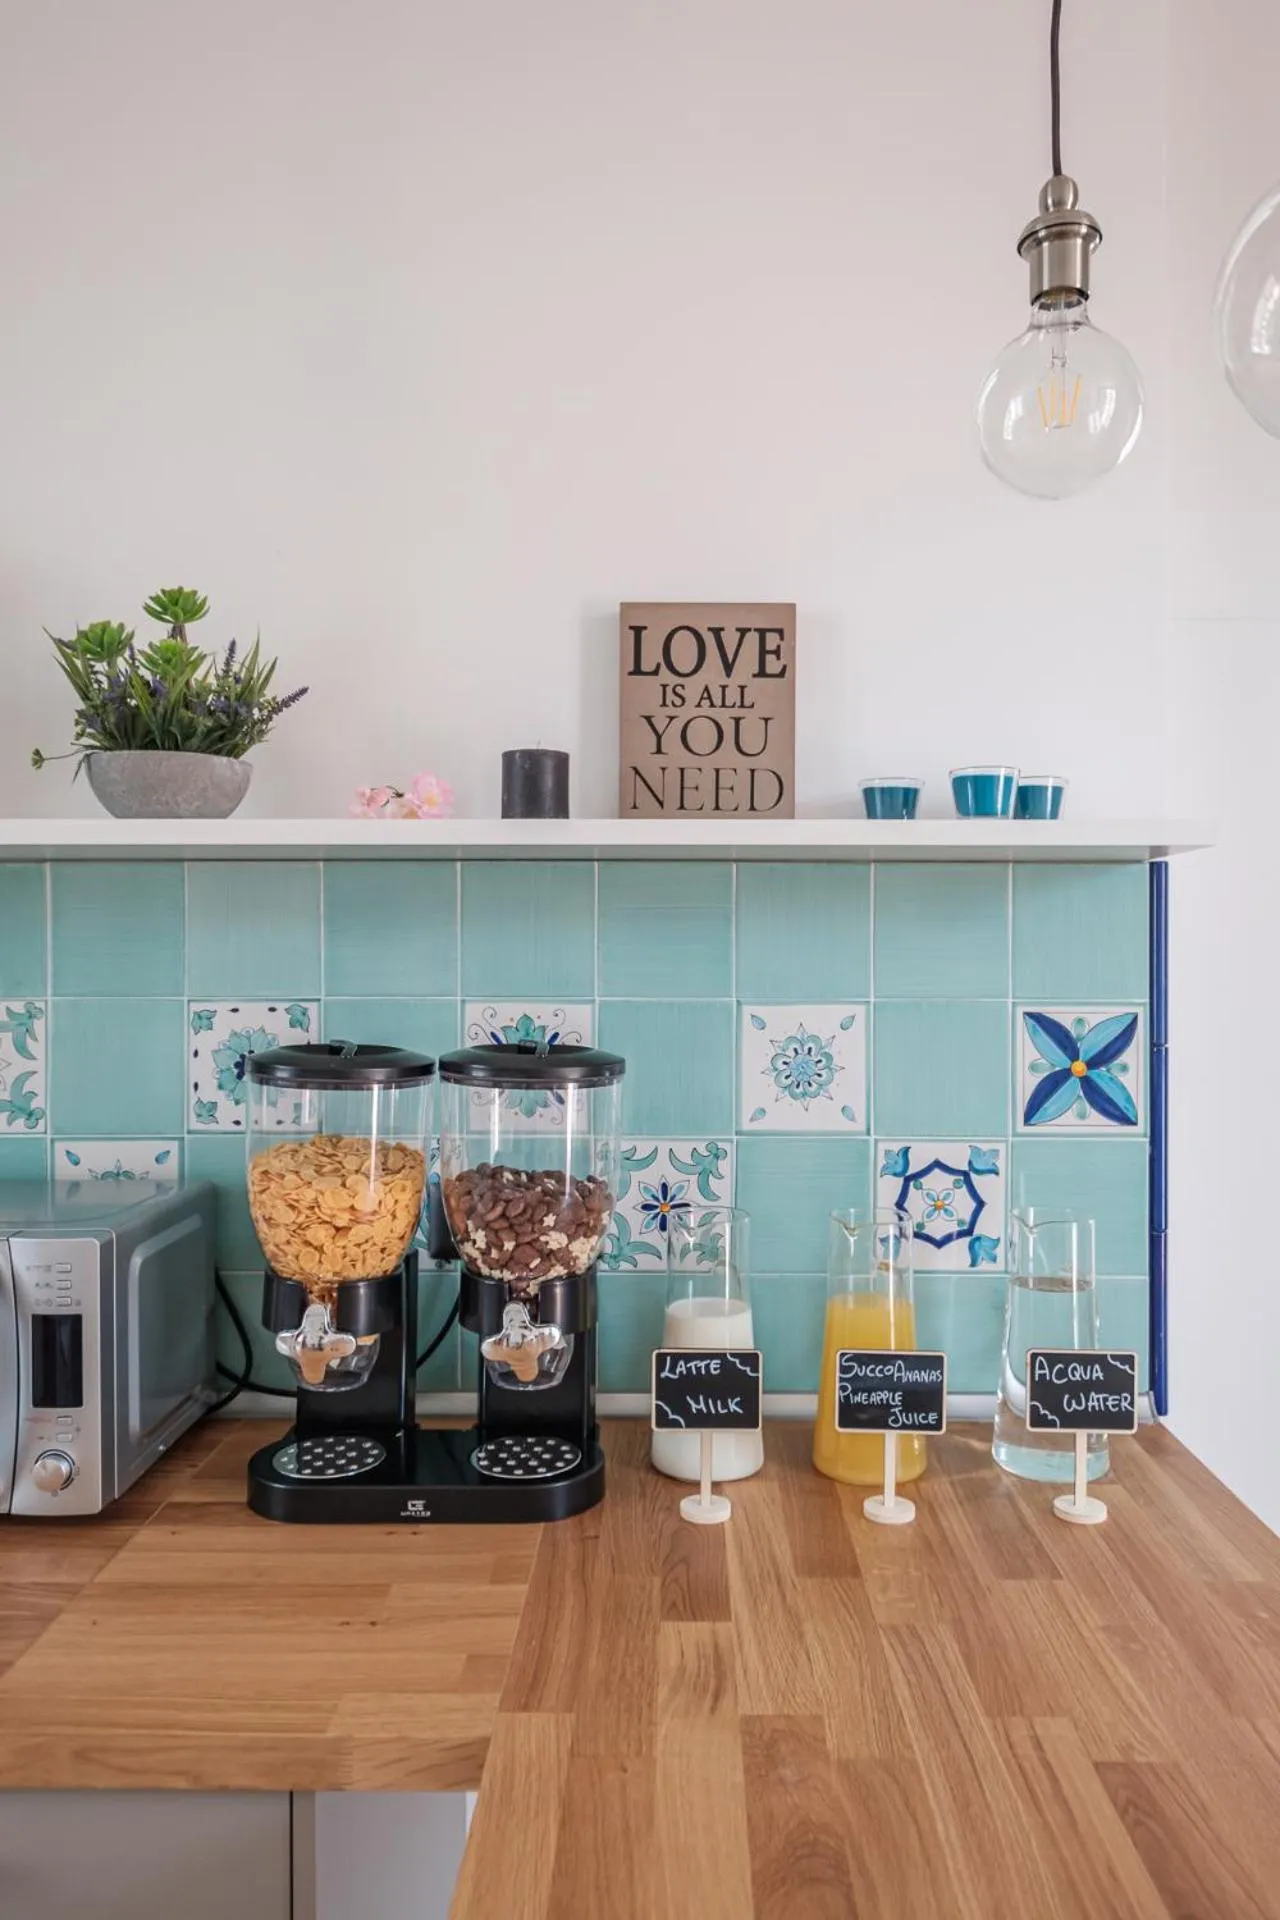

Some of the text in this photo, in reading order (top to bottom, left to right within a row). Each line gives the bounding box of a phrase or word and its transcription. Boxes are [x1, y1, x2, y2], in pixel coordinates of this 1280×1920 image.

[627, 625, 788, 679] LOVE
[659, 683, 755, 709] IS ALL
[640, 715, 775, 757] YOU
[629, 766, 784, 812] NEED
[660, 1356, 721, 1379] LATTE
[839, 1354, 943, 1383] SUCCO ANANAS
[1035, 1356, 1104, 1384] ACQUA
[686, 1394, 744, 1414] MILK
[838, 1382, 903, 1405] PINEAPPLE
[1063, 1391, 1135, 1412] WATER
[888, 1407, 939, 1428] JUICE
